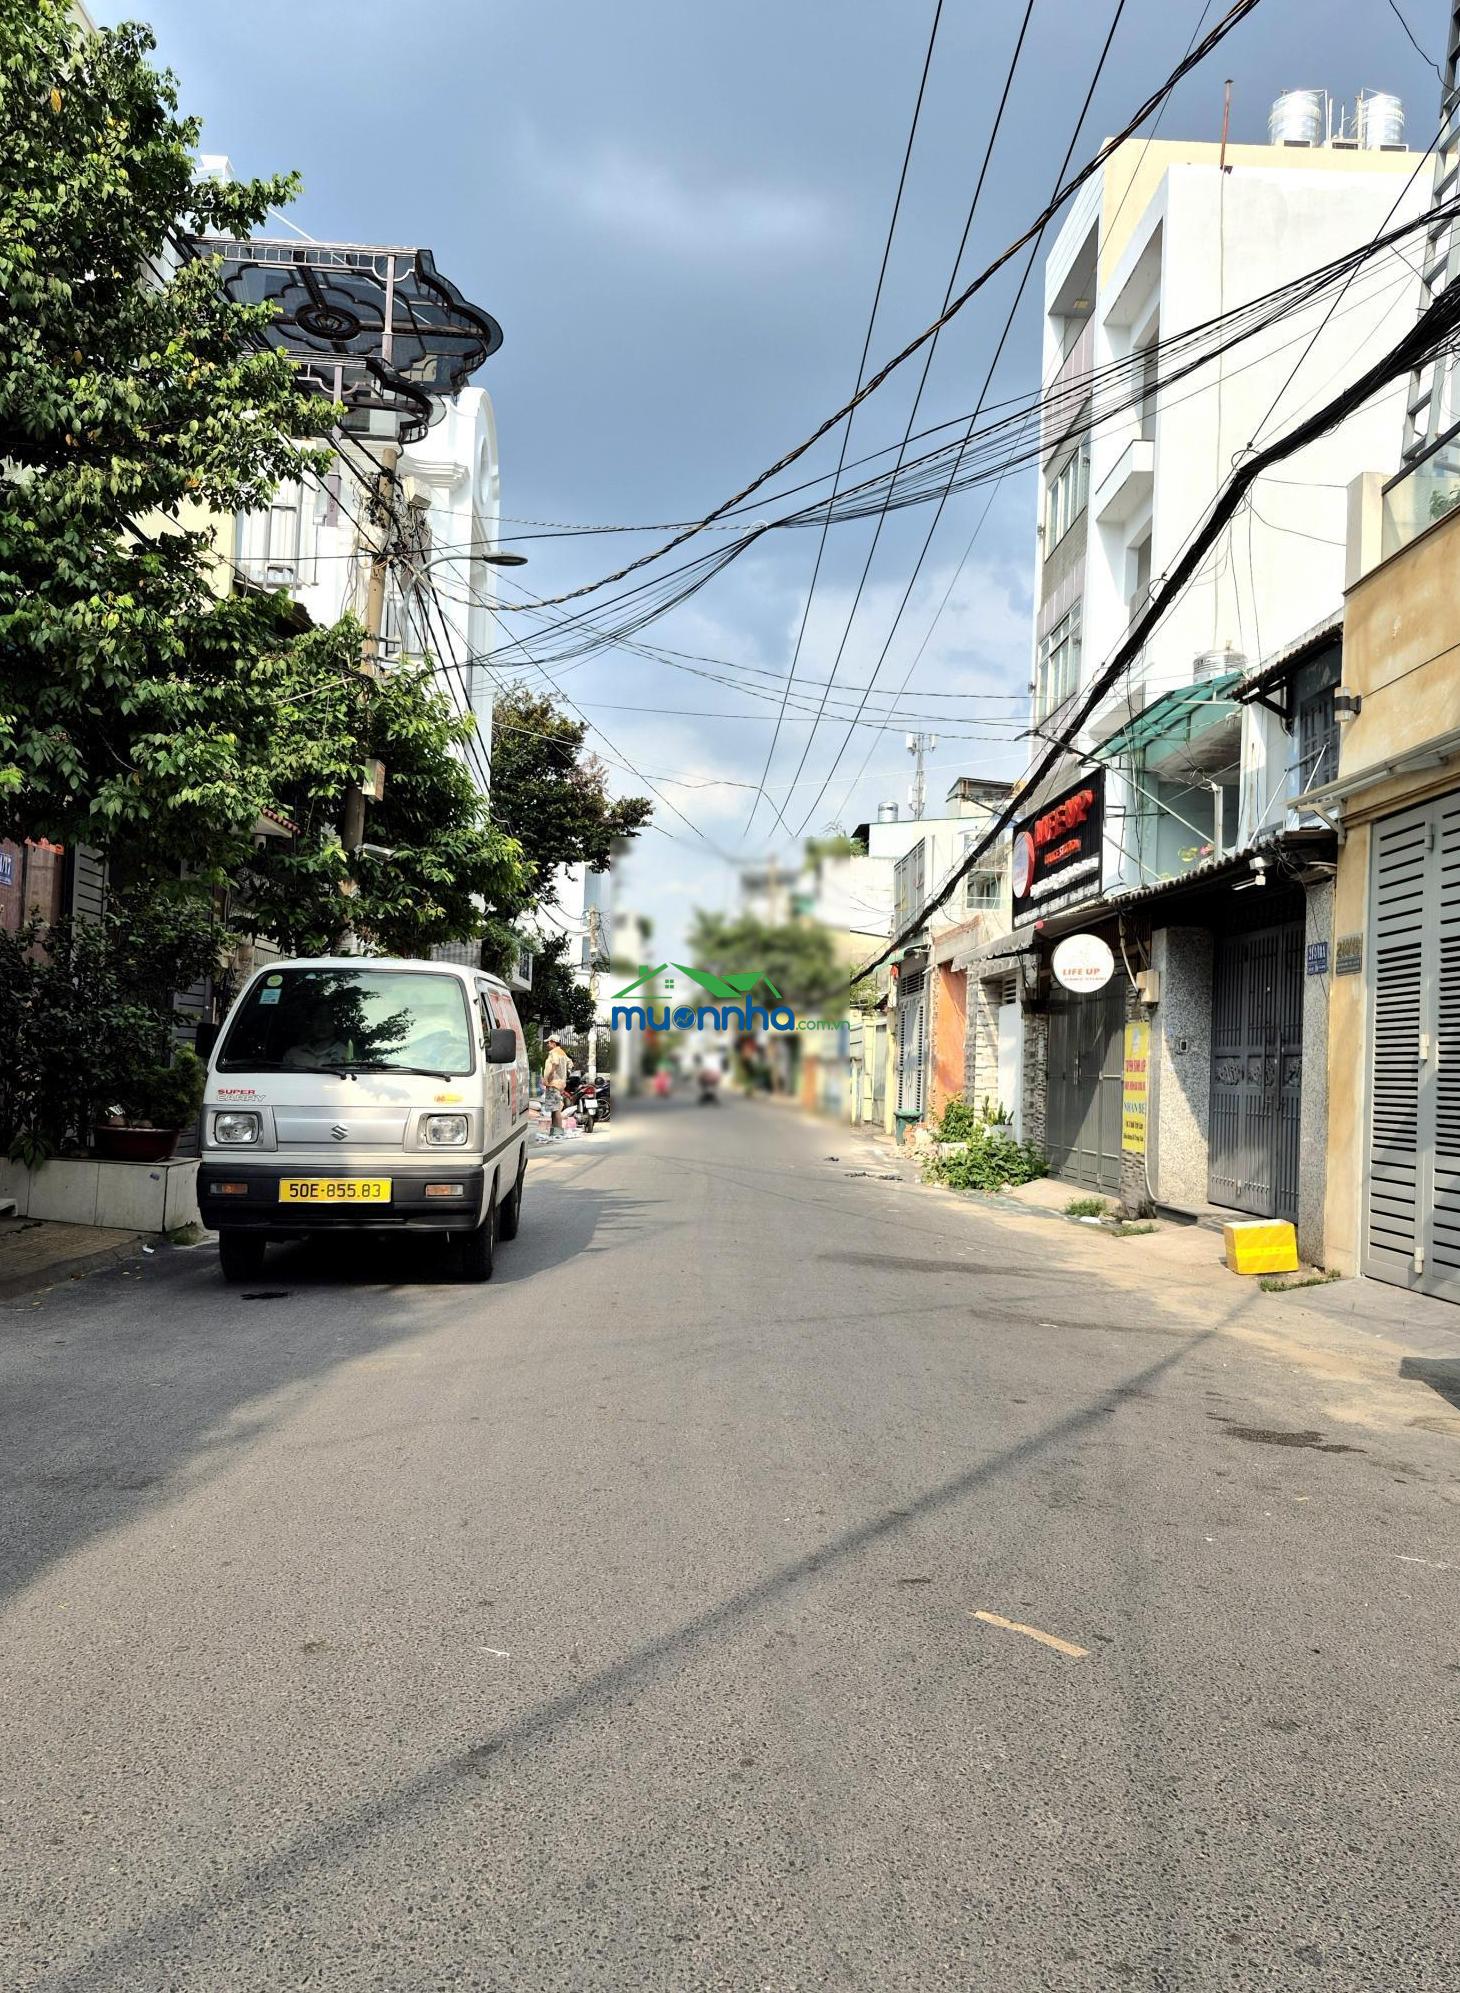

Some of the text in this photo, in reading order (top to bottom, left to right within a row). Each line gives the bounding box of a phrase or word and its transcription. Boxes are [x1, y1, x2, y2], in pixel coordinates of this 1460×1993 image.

[1062, 968, 1082, 976] LIFE
[216, 1094, 266, 1103] CARRY
[289, 1183, 381, 1198] 50E-855.83
